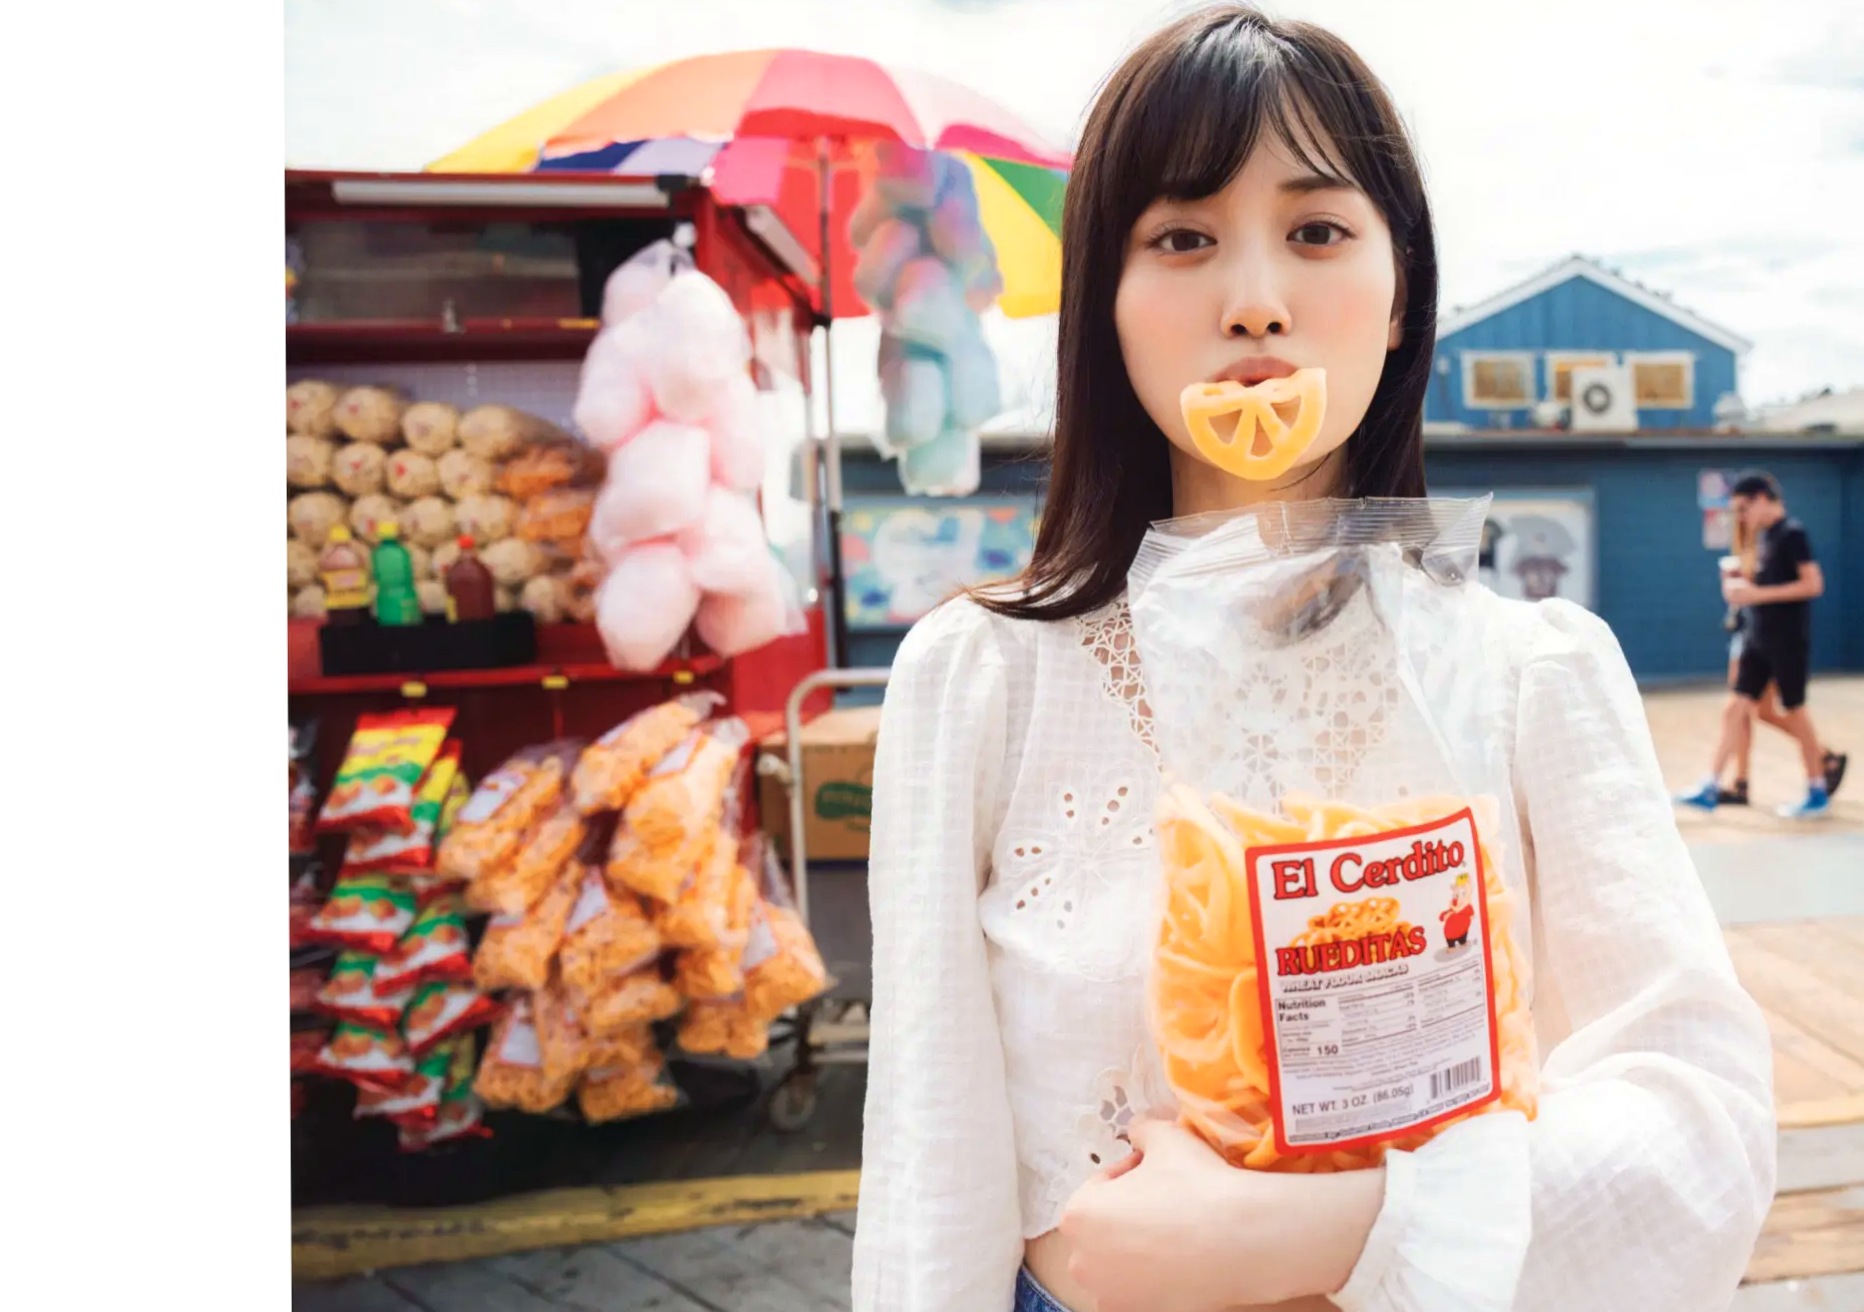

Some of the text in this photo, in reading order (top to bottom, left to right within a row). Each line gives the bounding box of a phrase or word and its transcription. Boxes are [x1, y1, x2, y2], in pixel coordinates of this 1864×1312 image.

[1272, 839, 1465, 900] El Cerdito
[1276, 925, 1428, 976] RUEDITAS
[1278, 998, 1326, 1011] Nutrition
[1279, 1011, 1309, 1022] Facts
[1317, 1044, 1339, 1056] 150
[1292, 1102, 1316, 1116] NET
[1342, 1097, 1349, 1110] 3
